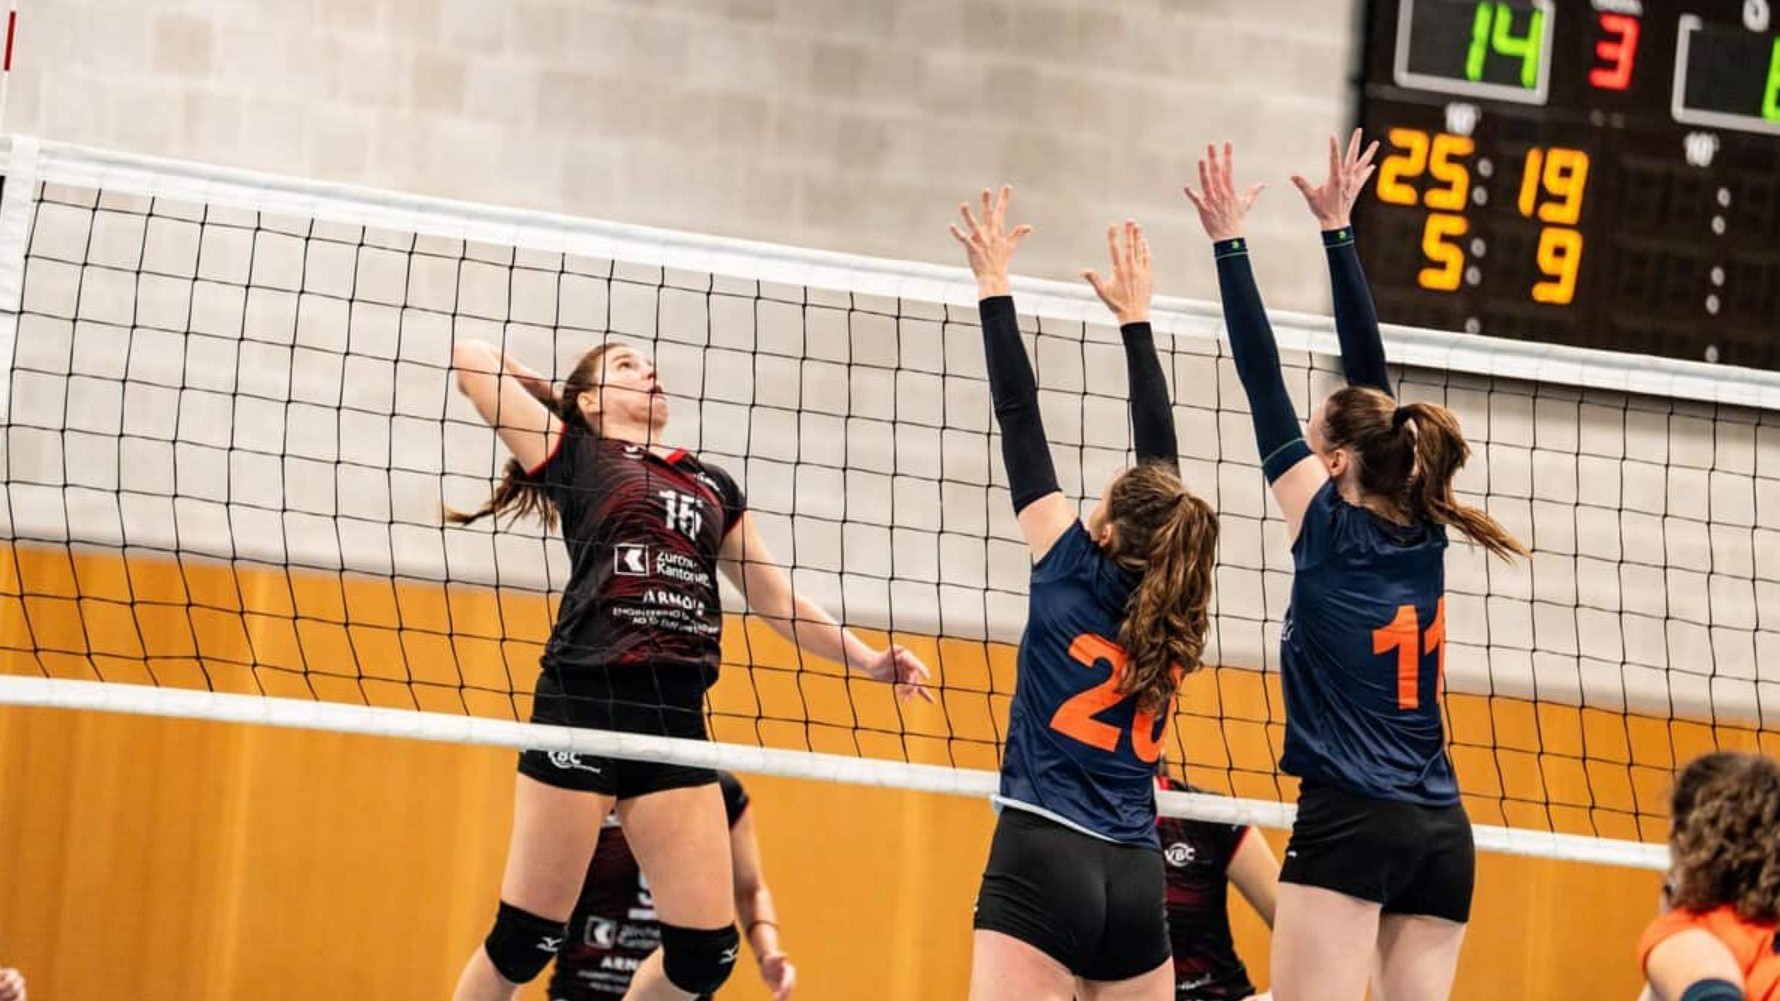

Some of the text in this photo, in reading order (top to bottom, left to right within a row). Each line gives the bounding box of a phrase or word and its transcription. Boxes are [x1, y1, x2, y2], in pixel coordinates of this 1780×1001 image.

[1465, 2, 1544, 88] 14
[1589, 11, 1640, 91] 3
[1376, 127, 1590, 225] 25 19
[1417, 212, 1584, 305] 5 9
[1164, 846, 1196, 862] VBC
[600, 956, 640, 971] ARN
